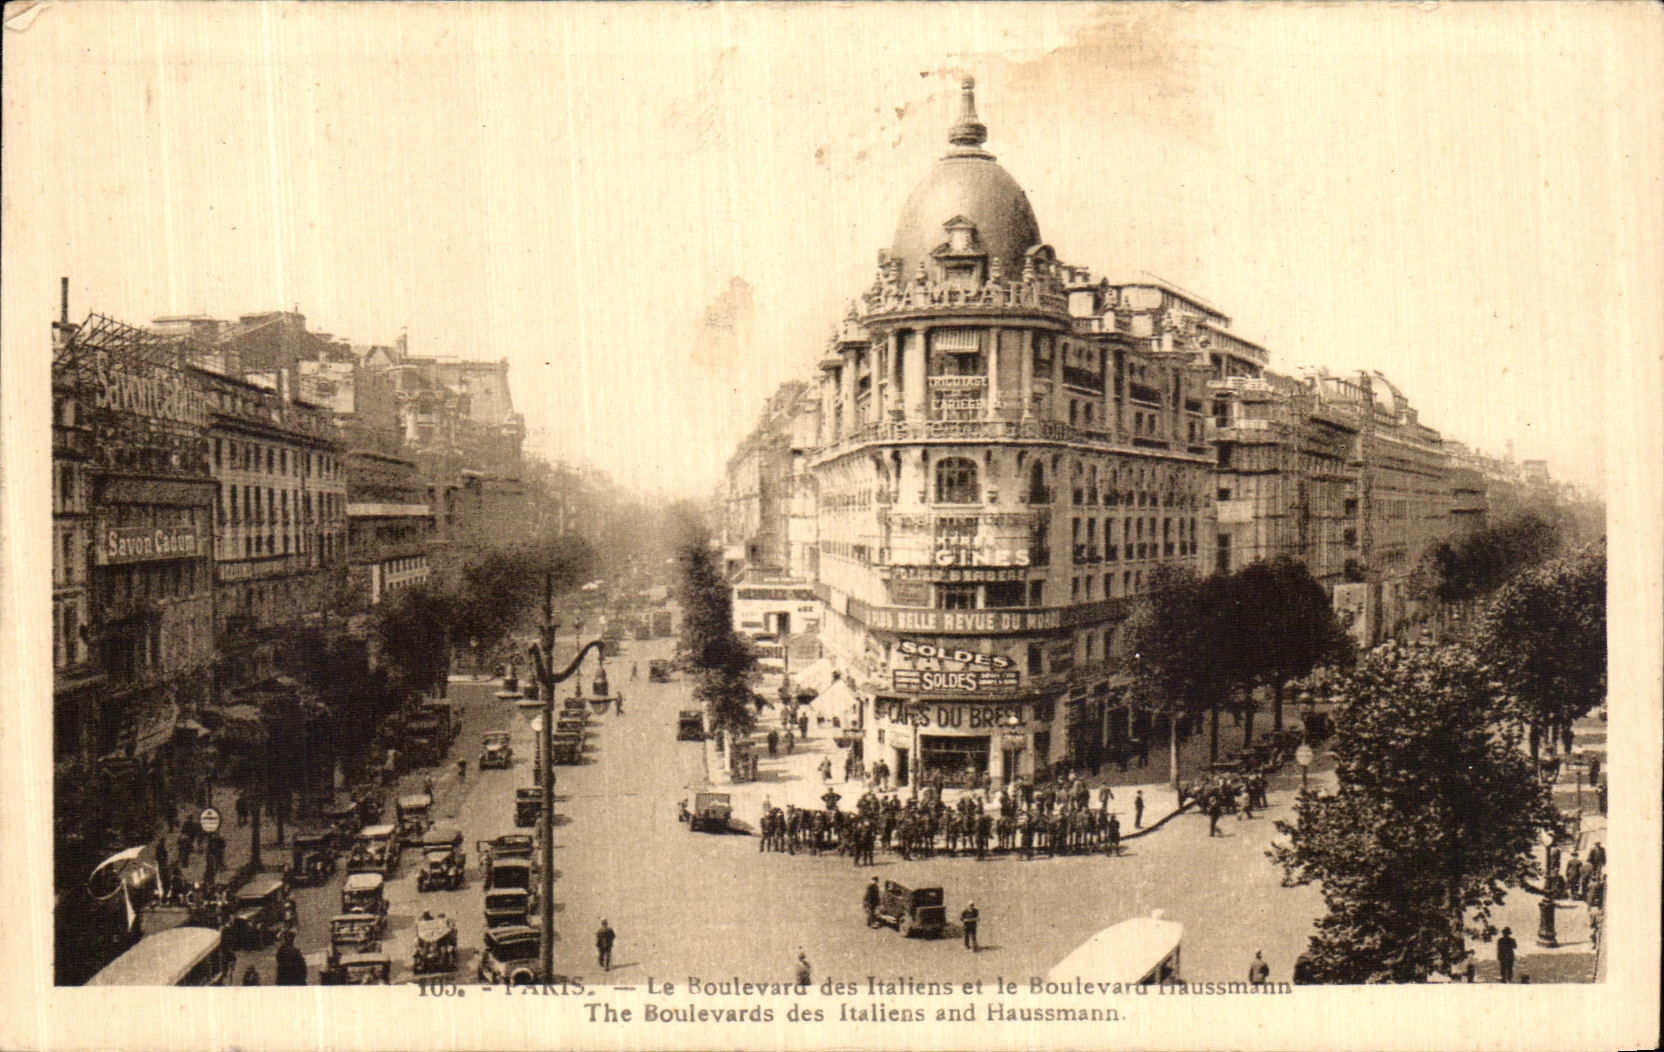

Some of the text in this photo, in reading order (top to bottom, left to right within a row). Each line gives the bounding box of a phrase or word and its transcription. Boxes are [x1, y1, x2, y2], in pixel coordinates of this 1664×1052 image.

[108, 529, 196, 556] Savon Cadum
[898, 612, 937, 629] BELLE
[943, 612, 995, 631] REVUE
[1001, 613, 1021, 630] DU
[900, 640, 1009, 668] SOLDES
[922, 672, 977, 691] SOLDES
[937, 704, 962, 729] DU
